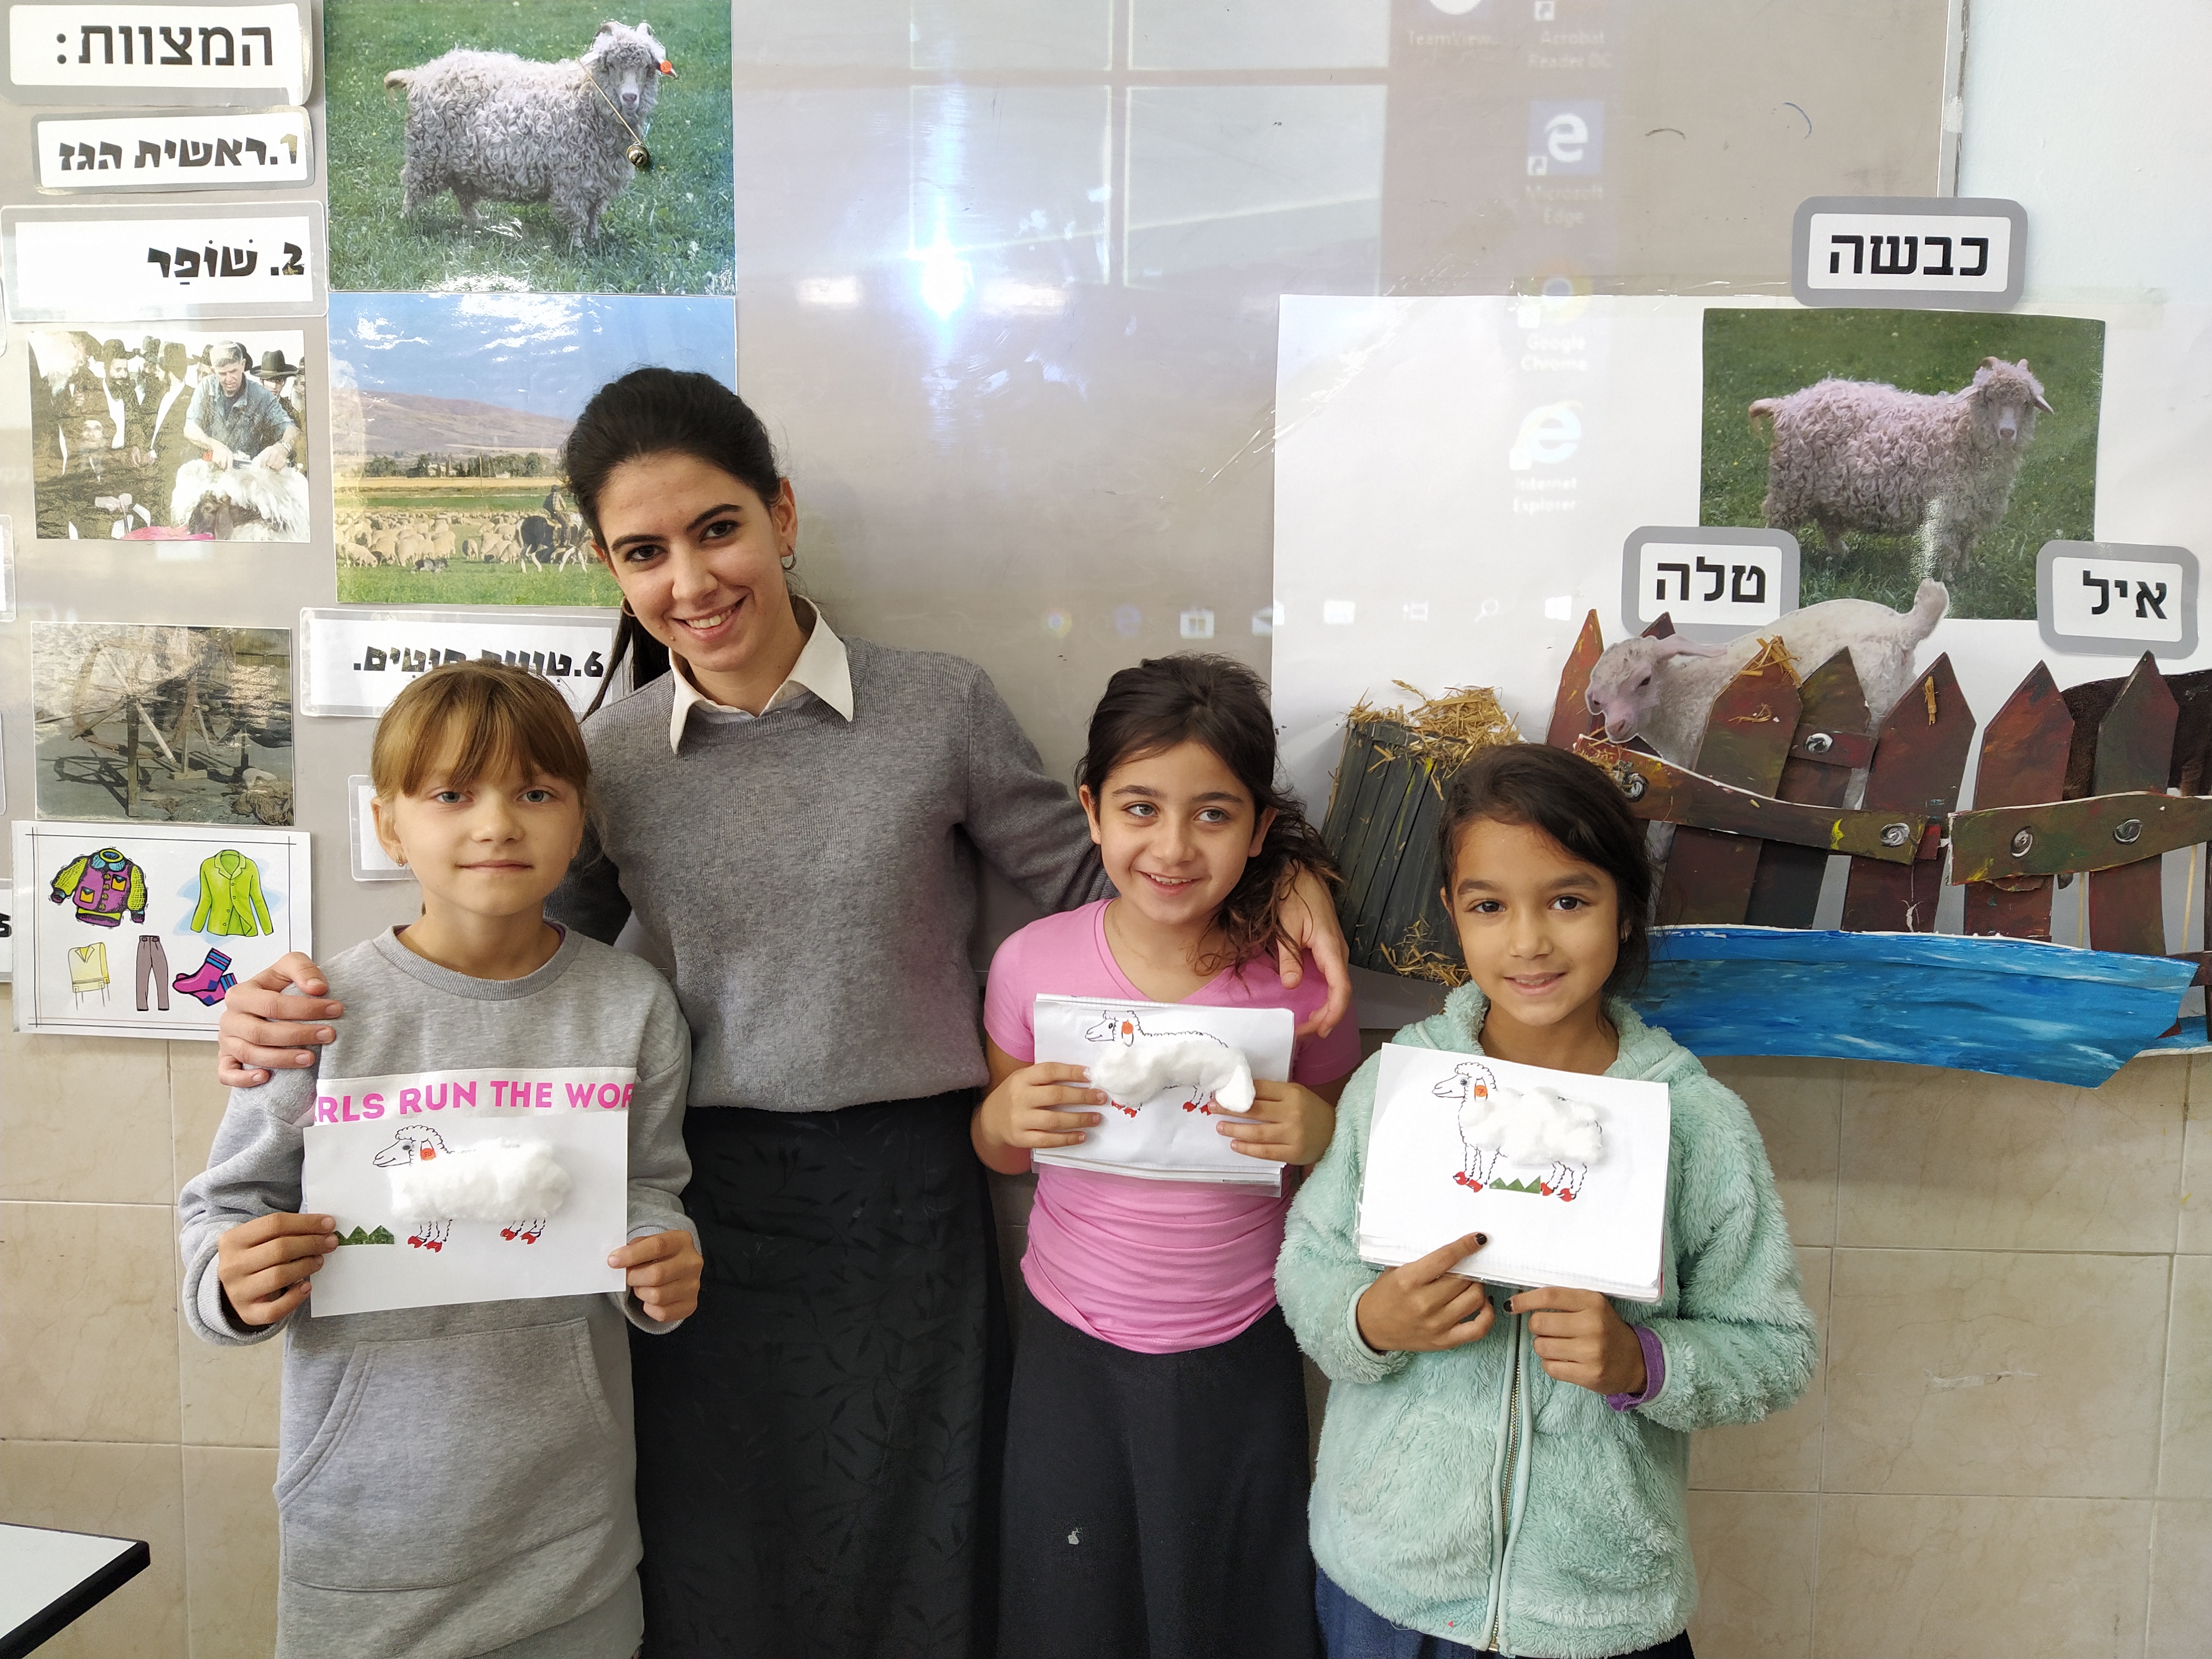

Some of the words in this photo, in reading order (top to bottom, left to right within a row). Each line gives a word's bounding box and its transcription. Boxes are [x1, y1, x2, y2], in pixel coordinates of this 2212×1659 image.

[57, 25, 273, 66] המצוות:
[1541, 30, 1605, 45] Acrobat
[59, 141, 122, 170] הגז
[134, 133, 298, 168] 1.ראשית
[1544, 207, 1584, 227] Edge
[270, 242, 305, 276] 2.
[1829, 234, 1989, 276] כבשה
[1526, 333, 1585, 353] Google
[1521, 354, 1588, 371] Chrome
[1515, 477, 1577, 491] Internet
[1513, 497, 1576, 515] Explorer
[1656, 556, 1766, 603] טלה
[2083, 570, 2167, 620] איל
[314, 1093, 384, 1123] RLS
[400, 1081, 477, 1115] RUN
[490, 1081, 552, 1108] THE
